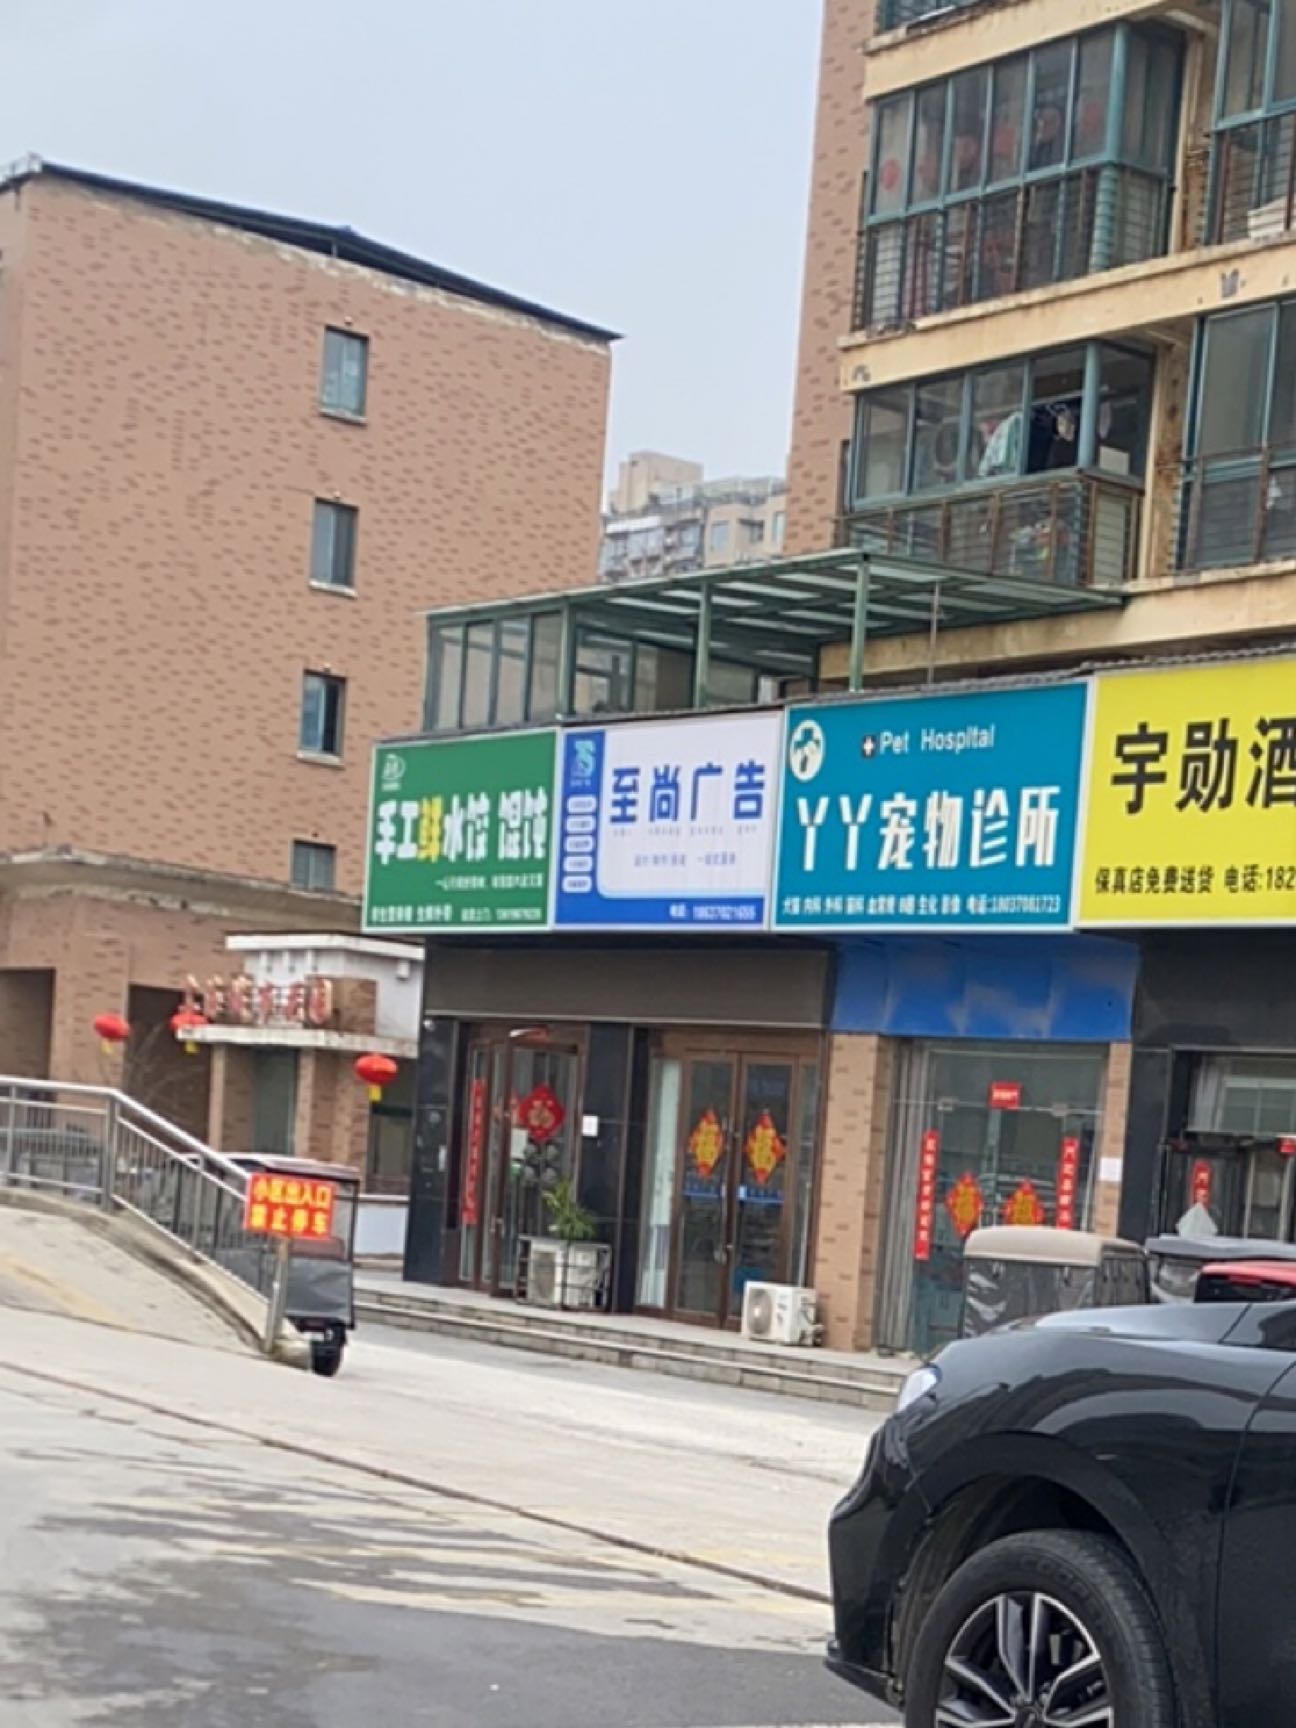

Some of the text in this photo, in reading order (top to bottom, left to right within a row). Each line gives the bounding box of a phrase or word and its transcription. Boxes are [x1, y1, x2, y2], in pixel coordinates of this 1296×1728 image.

[879, 723, 995, 754] Pet Hospital
[609, 758, 766, 824] 至尚广告
[1095, 866, 1214, 894] 保真店免费送货
